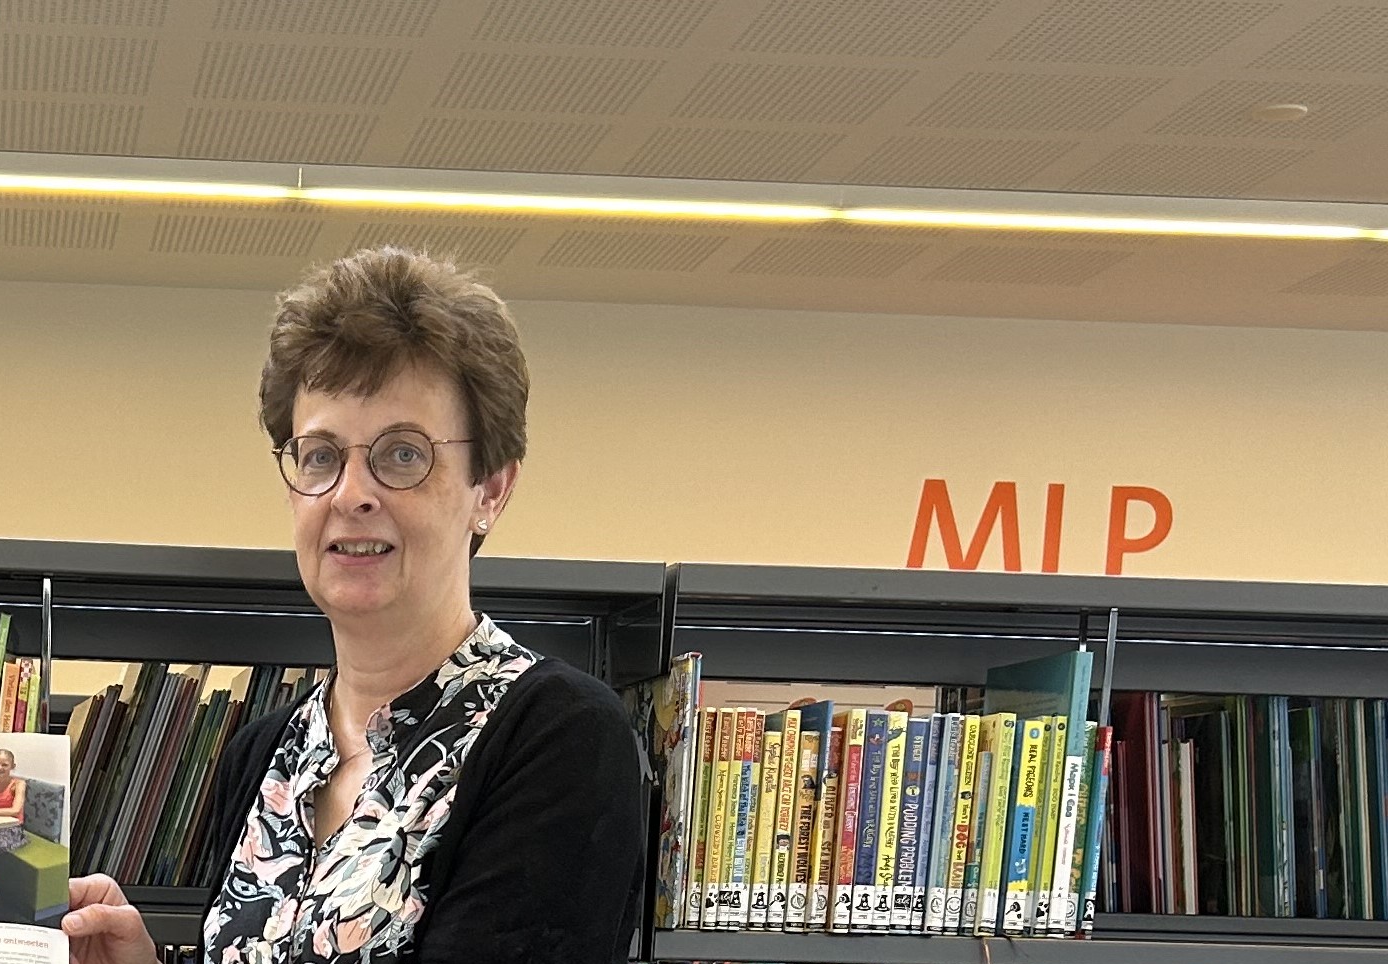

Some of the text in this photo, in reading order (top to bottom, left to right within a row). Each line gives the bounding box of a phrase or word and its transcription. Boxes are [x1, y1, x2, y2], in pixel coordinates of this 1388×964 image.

[1068, 763, 1078, 791] Марк
[823, 786, 835, 818] OLIVER
[1019, 744, 1038, 854] REAL PIGEONS NEST HARD
[902, 803, 918, 844] PUDDING
[956, 824, 969, 849] DOG
[795, 805, 813, 883] THE FOREST WOLVES
